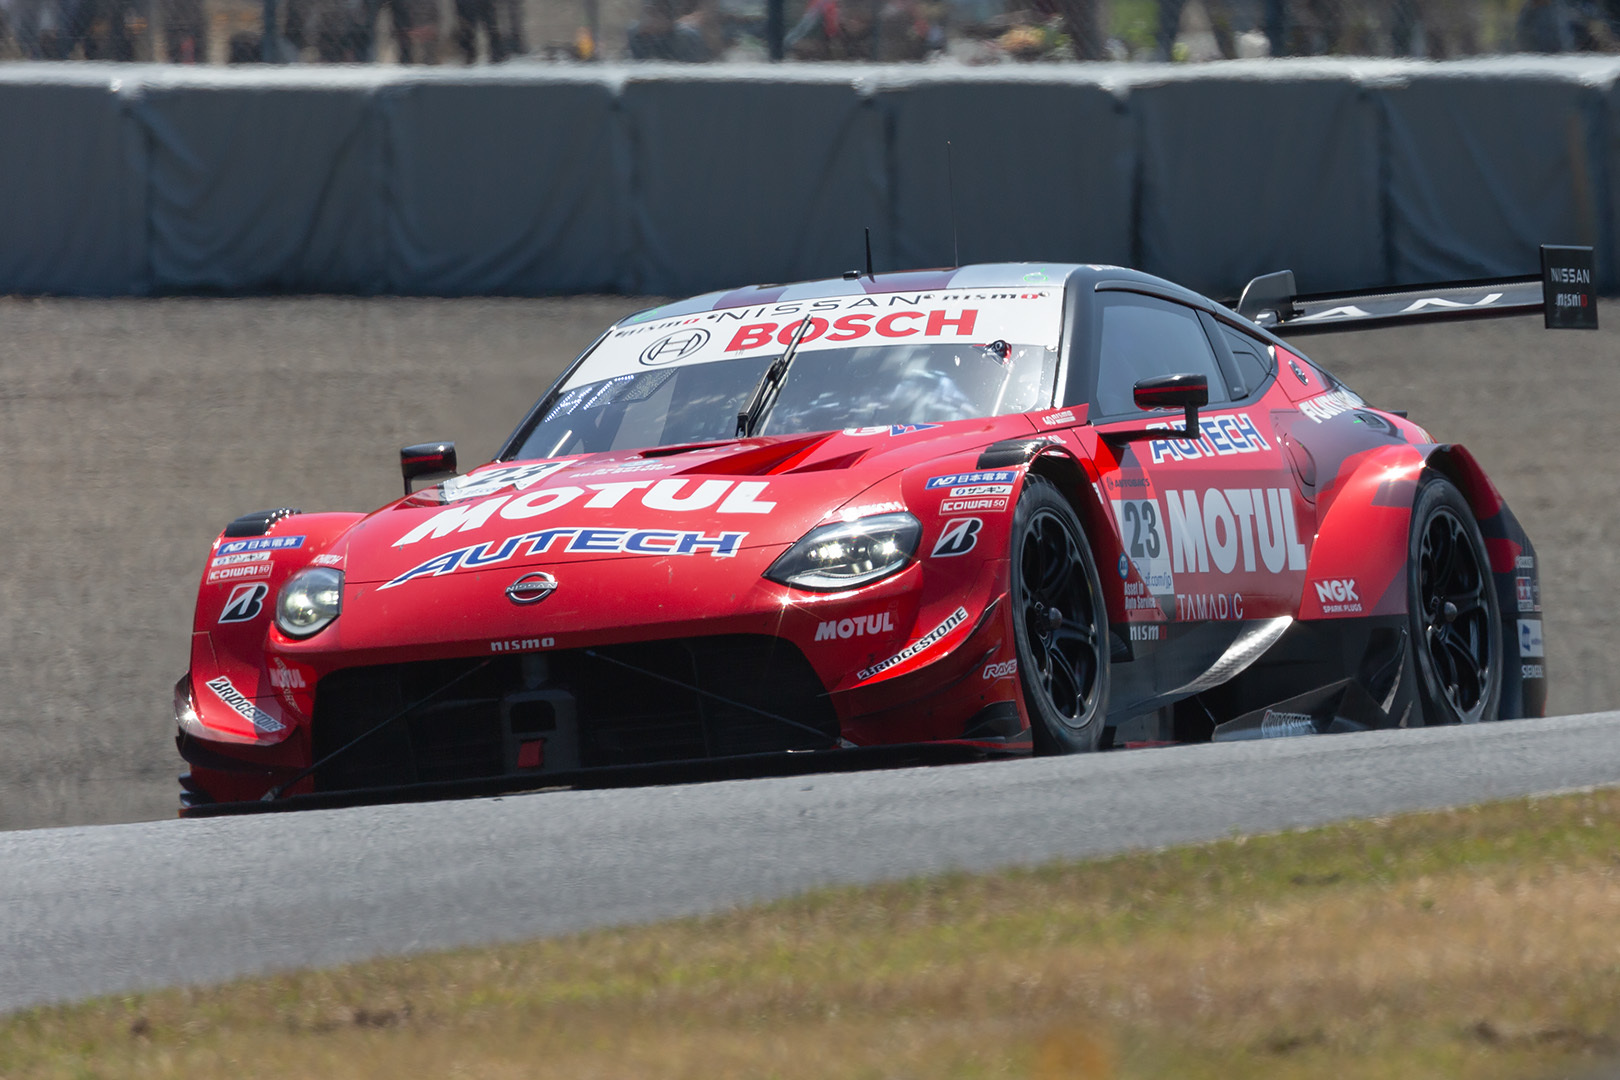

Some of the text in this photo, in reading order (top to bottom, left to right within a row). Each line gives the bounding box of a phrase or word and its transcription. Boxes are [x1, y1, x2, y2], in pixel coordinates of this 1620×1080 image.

[1551, 267, 1590, 283] NISSAN
[716, 295, 922, 323] NISSAN
[1556, 293, 1588, 308] nismo
[724, 309, 979, 352] BOSCH
[1146, 413, 1272, 465] AUTECH
[465, 462, 562, 487] 23
[958, 472, 1009, 484] 日本電算
[1115, 478, 1150, 488] AUTOBACS
[967, 485, 1007, 495] サンキン
[391, 478, 777, 547] MOTUL
[942, 499, 1006, 512] KOIWAI 50
[1124, 500, 1161, 559] 23
[1165, 487, 1307, 574] MOTUL
[376, 526, 749, 591] AUTECH
[209, 566, 258, 580] KOIWAI
[505, 582, 557, 592] NISSAN
[1313, 579, 1359, 603] NGK
[1177, 593, 1244, 621] TAMADIC
[1322, 603, 1363, 613] SPARK PLUGS
[814, 612, 894, 642] MOTUL
[1130, 625, 1167, 641] nismo
[490, 636, 556, 652] nismo
[857, 606, 969, 681] BRIDGESTONE
[982, 659, 1018, 680] RAYS
[205, 675, 287, 733] BRIDGESTONE
